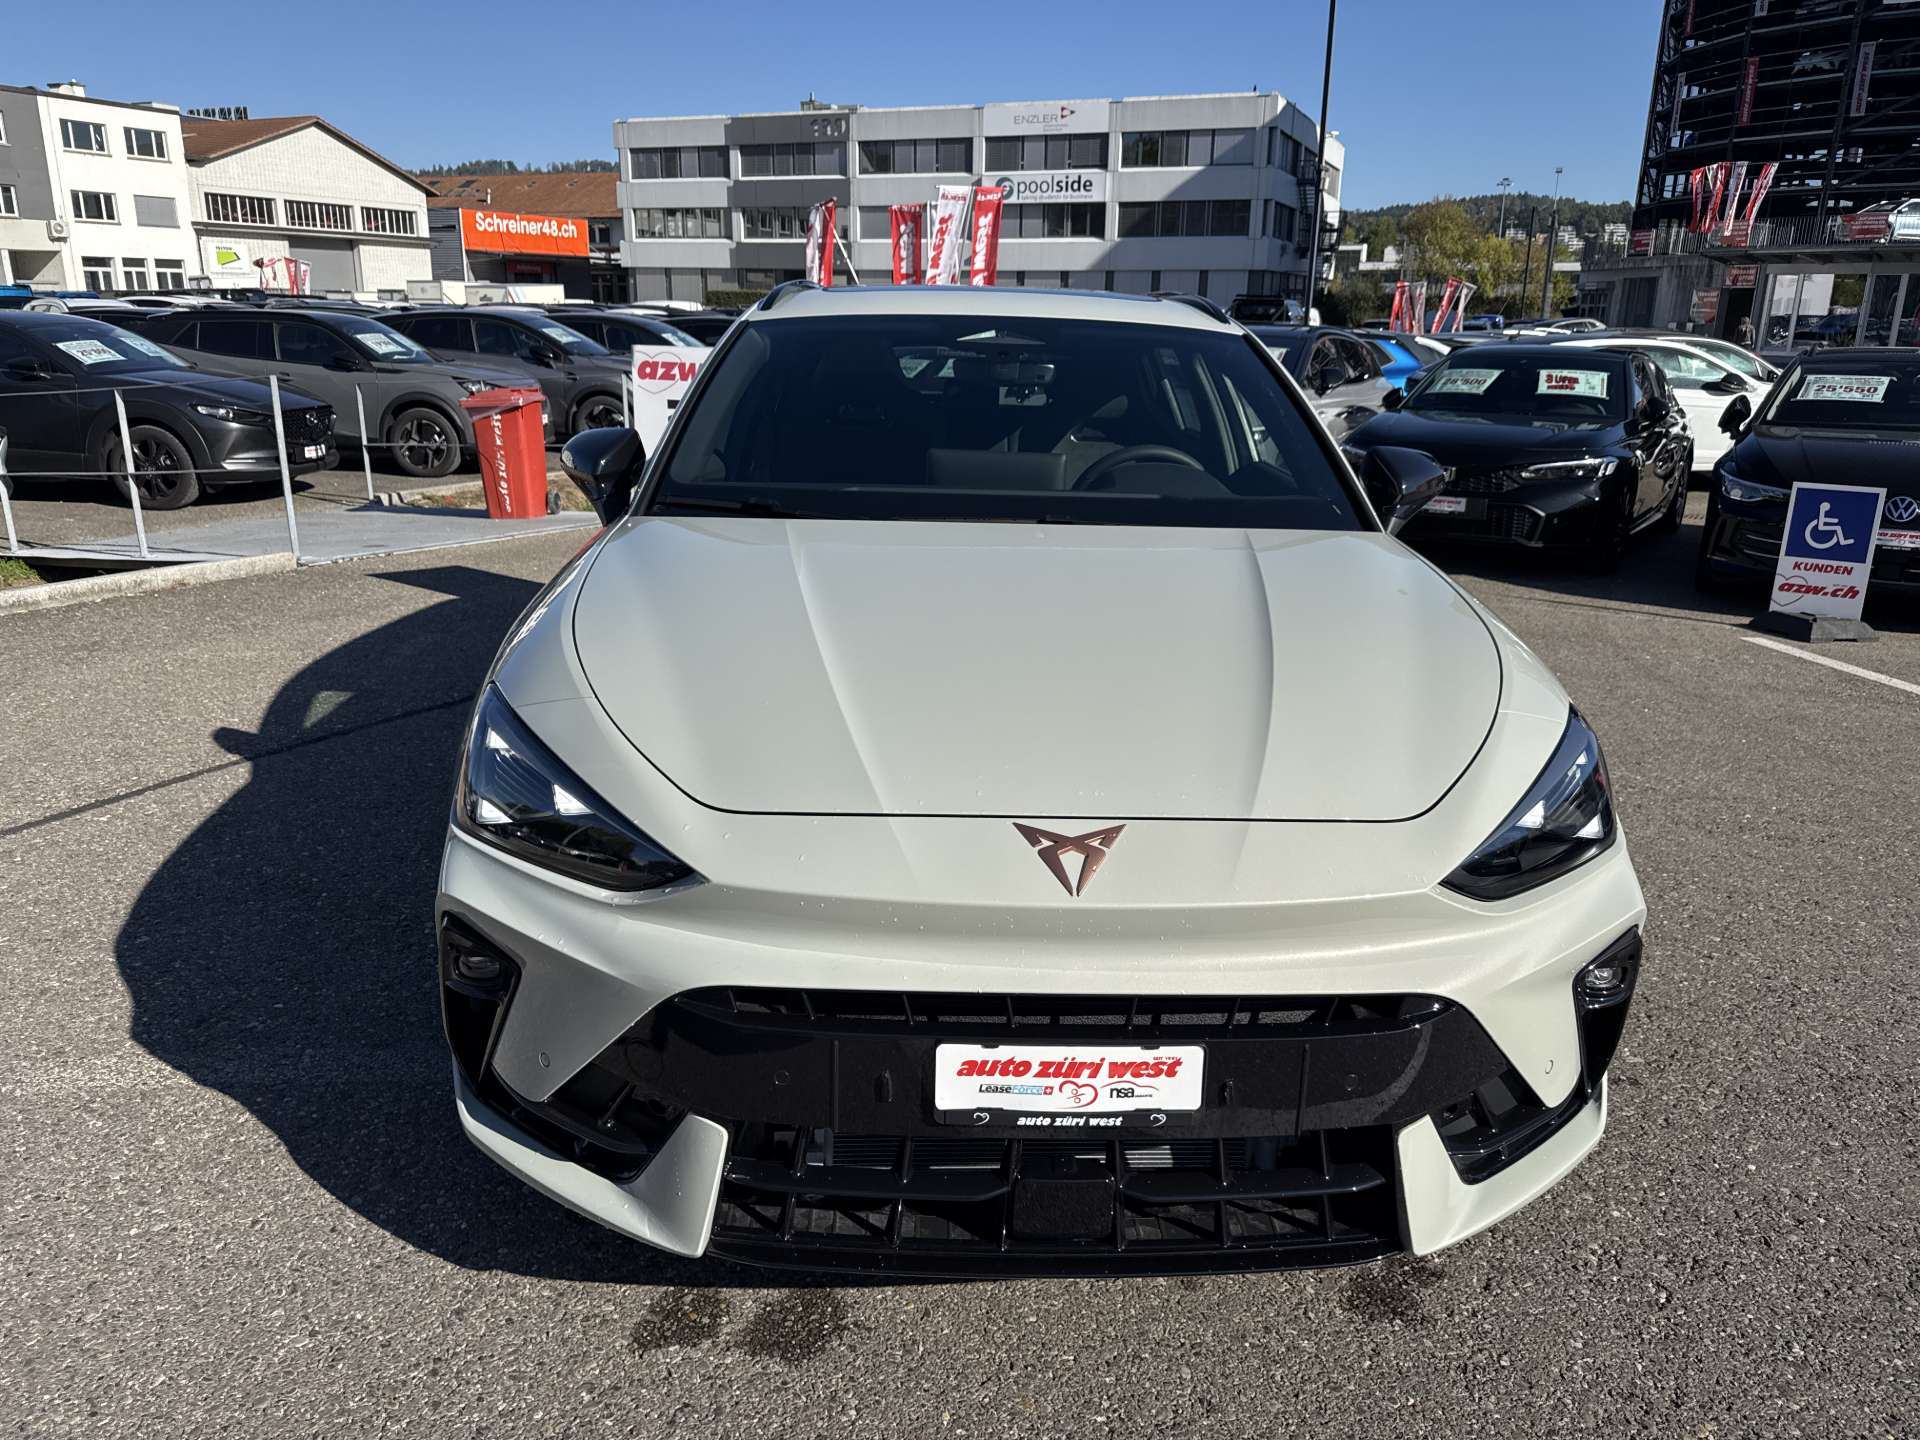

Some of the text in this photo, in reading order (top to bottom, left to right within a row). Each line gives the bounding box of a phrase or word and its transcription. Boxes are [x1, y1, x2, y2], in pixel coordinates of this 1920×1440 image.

[1014, 114, 1058, 124] ENZLER
[1017, 175, 1093, 200] poolside
[475, 211, 577, 238] Schreiner48.ch
[1814, 384, 1879, 394] 25'550
[1792, 561, 1854, 576] KUNDEN
[1777, 582, 1860, 600] azw.ch
[956, 1056, 1183, 1079] auto züri west
[1109, 1086, 1135, 1098] nsa
[1017, 1115, 1123, 1126] auto züri west
